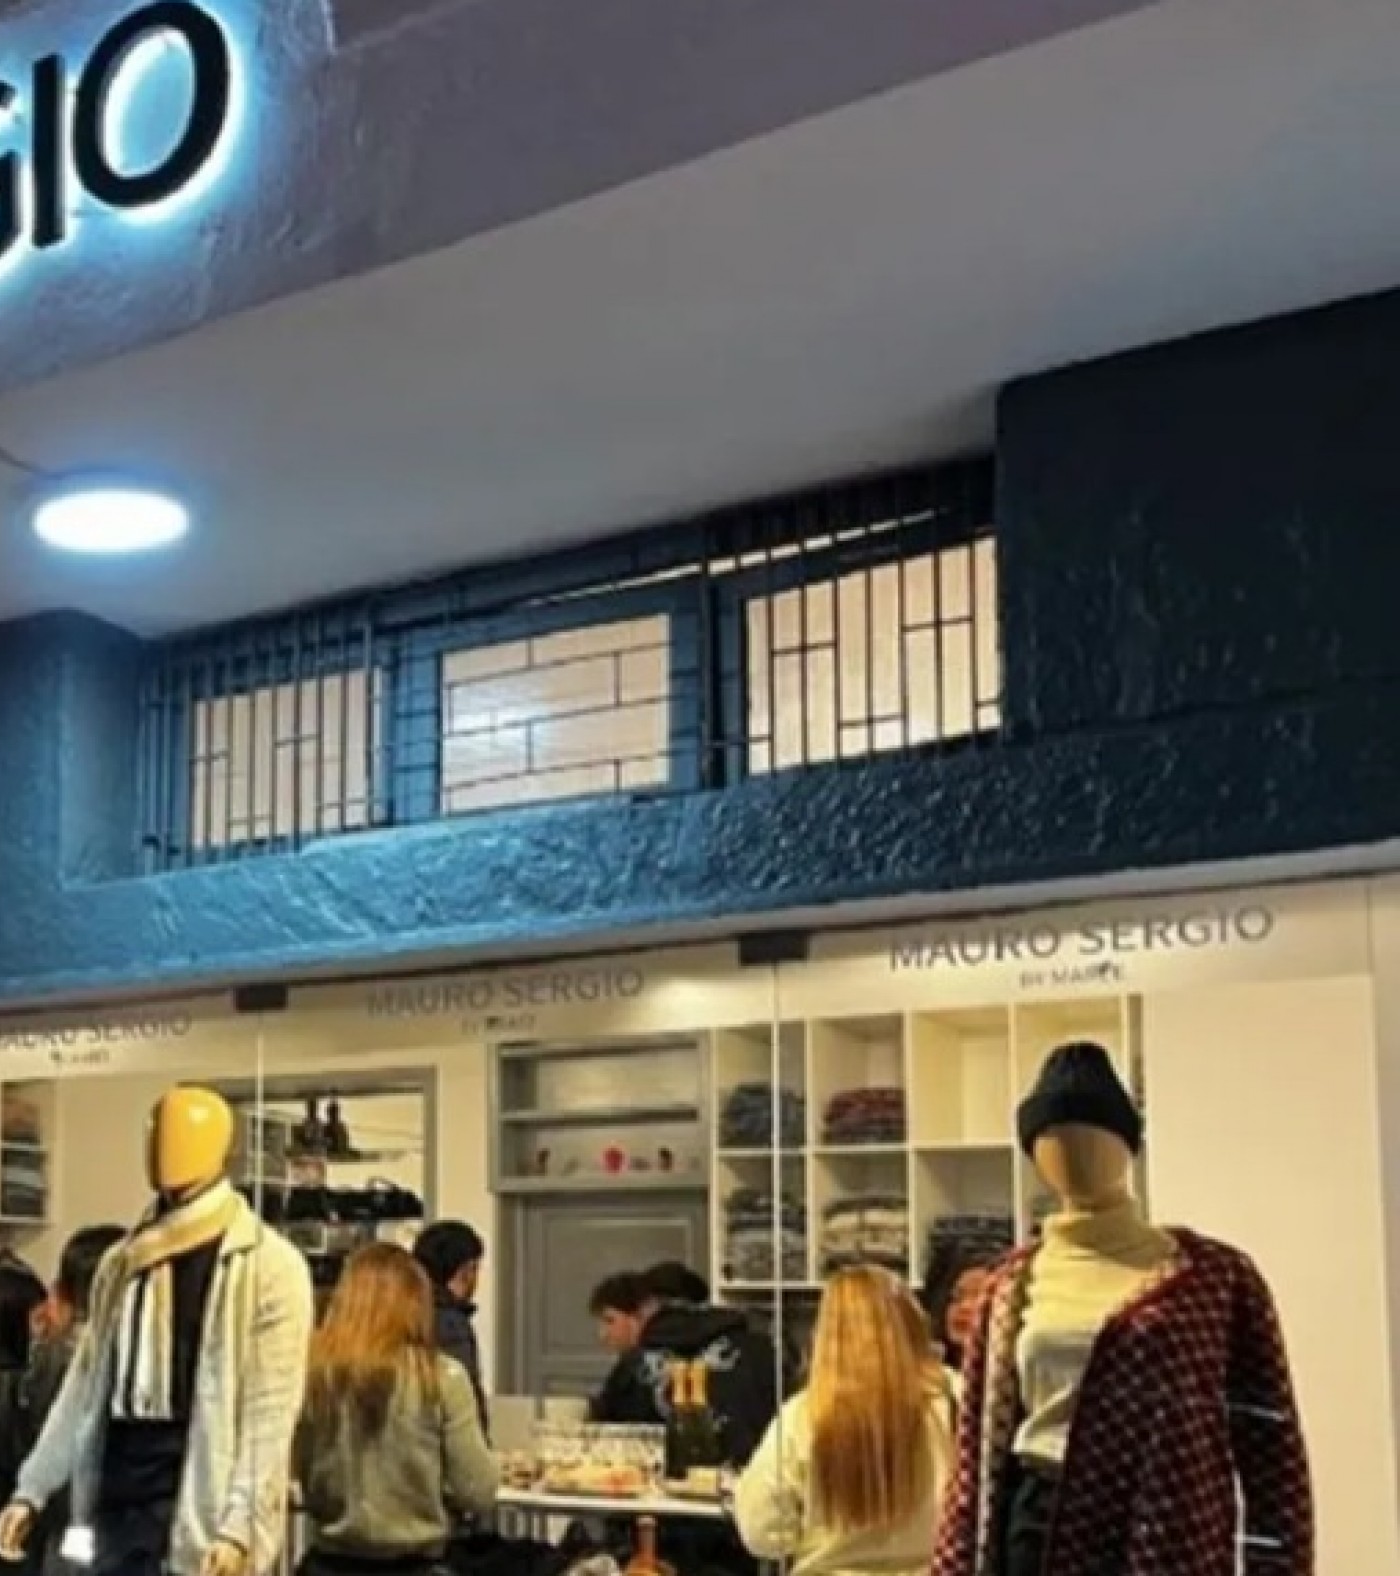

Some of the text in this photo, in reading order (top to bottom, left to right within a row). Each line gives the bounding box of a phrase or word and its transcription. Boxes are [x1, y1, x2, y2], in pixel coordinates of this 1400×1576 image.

[889, 904, 1276, 973] MAURO SERGIO
[366, 964, 645, 1018] MAURO SERGIO
